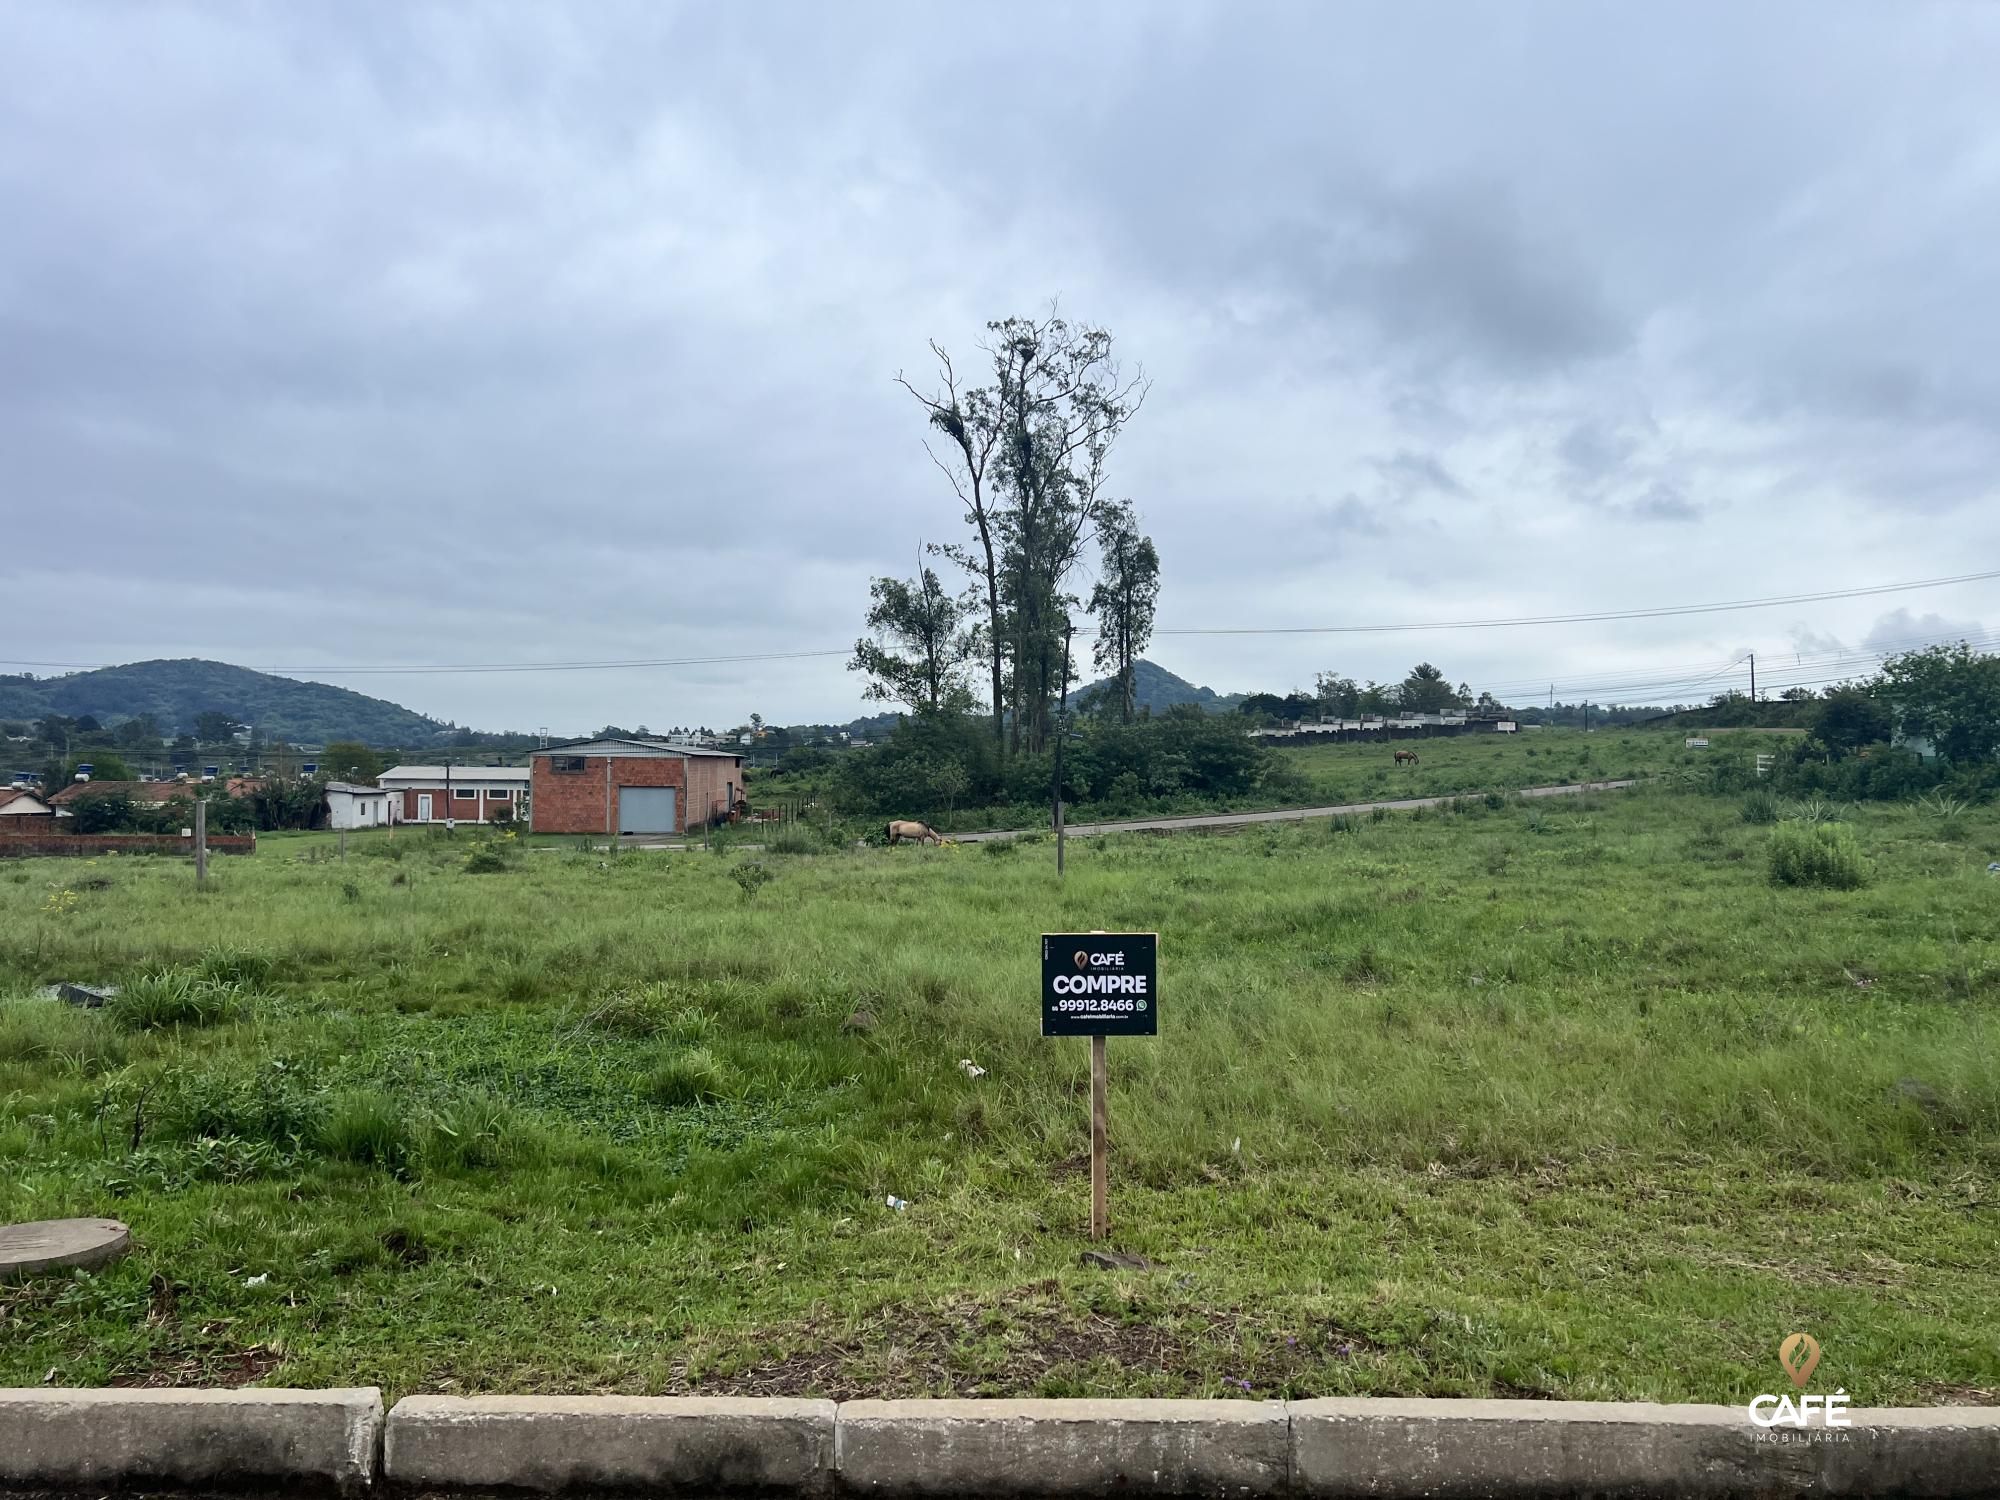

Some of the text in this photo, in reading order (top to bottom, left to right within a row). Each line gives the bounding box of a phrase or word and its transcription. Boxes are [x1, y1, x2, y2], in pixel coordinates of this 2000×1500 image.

[1090, 951, 1125, 966] CAFÉ
[1053, 975, 1147, 994] COMPRE
[1059, 1000, 1134, 1012] 99912.8466
